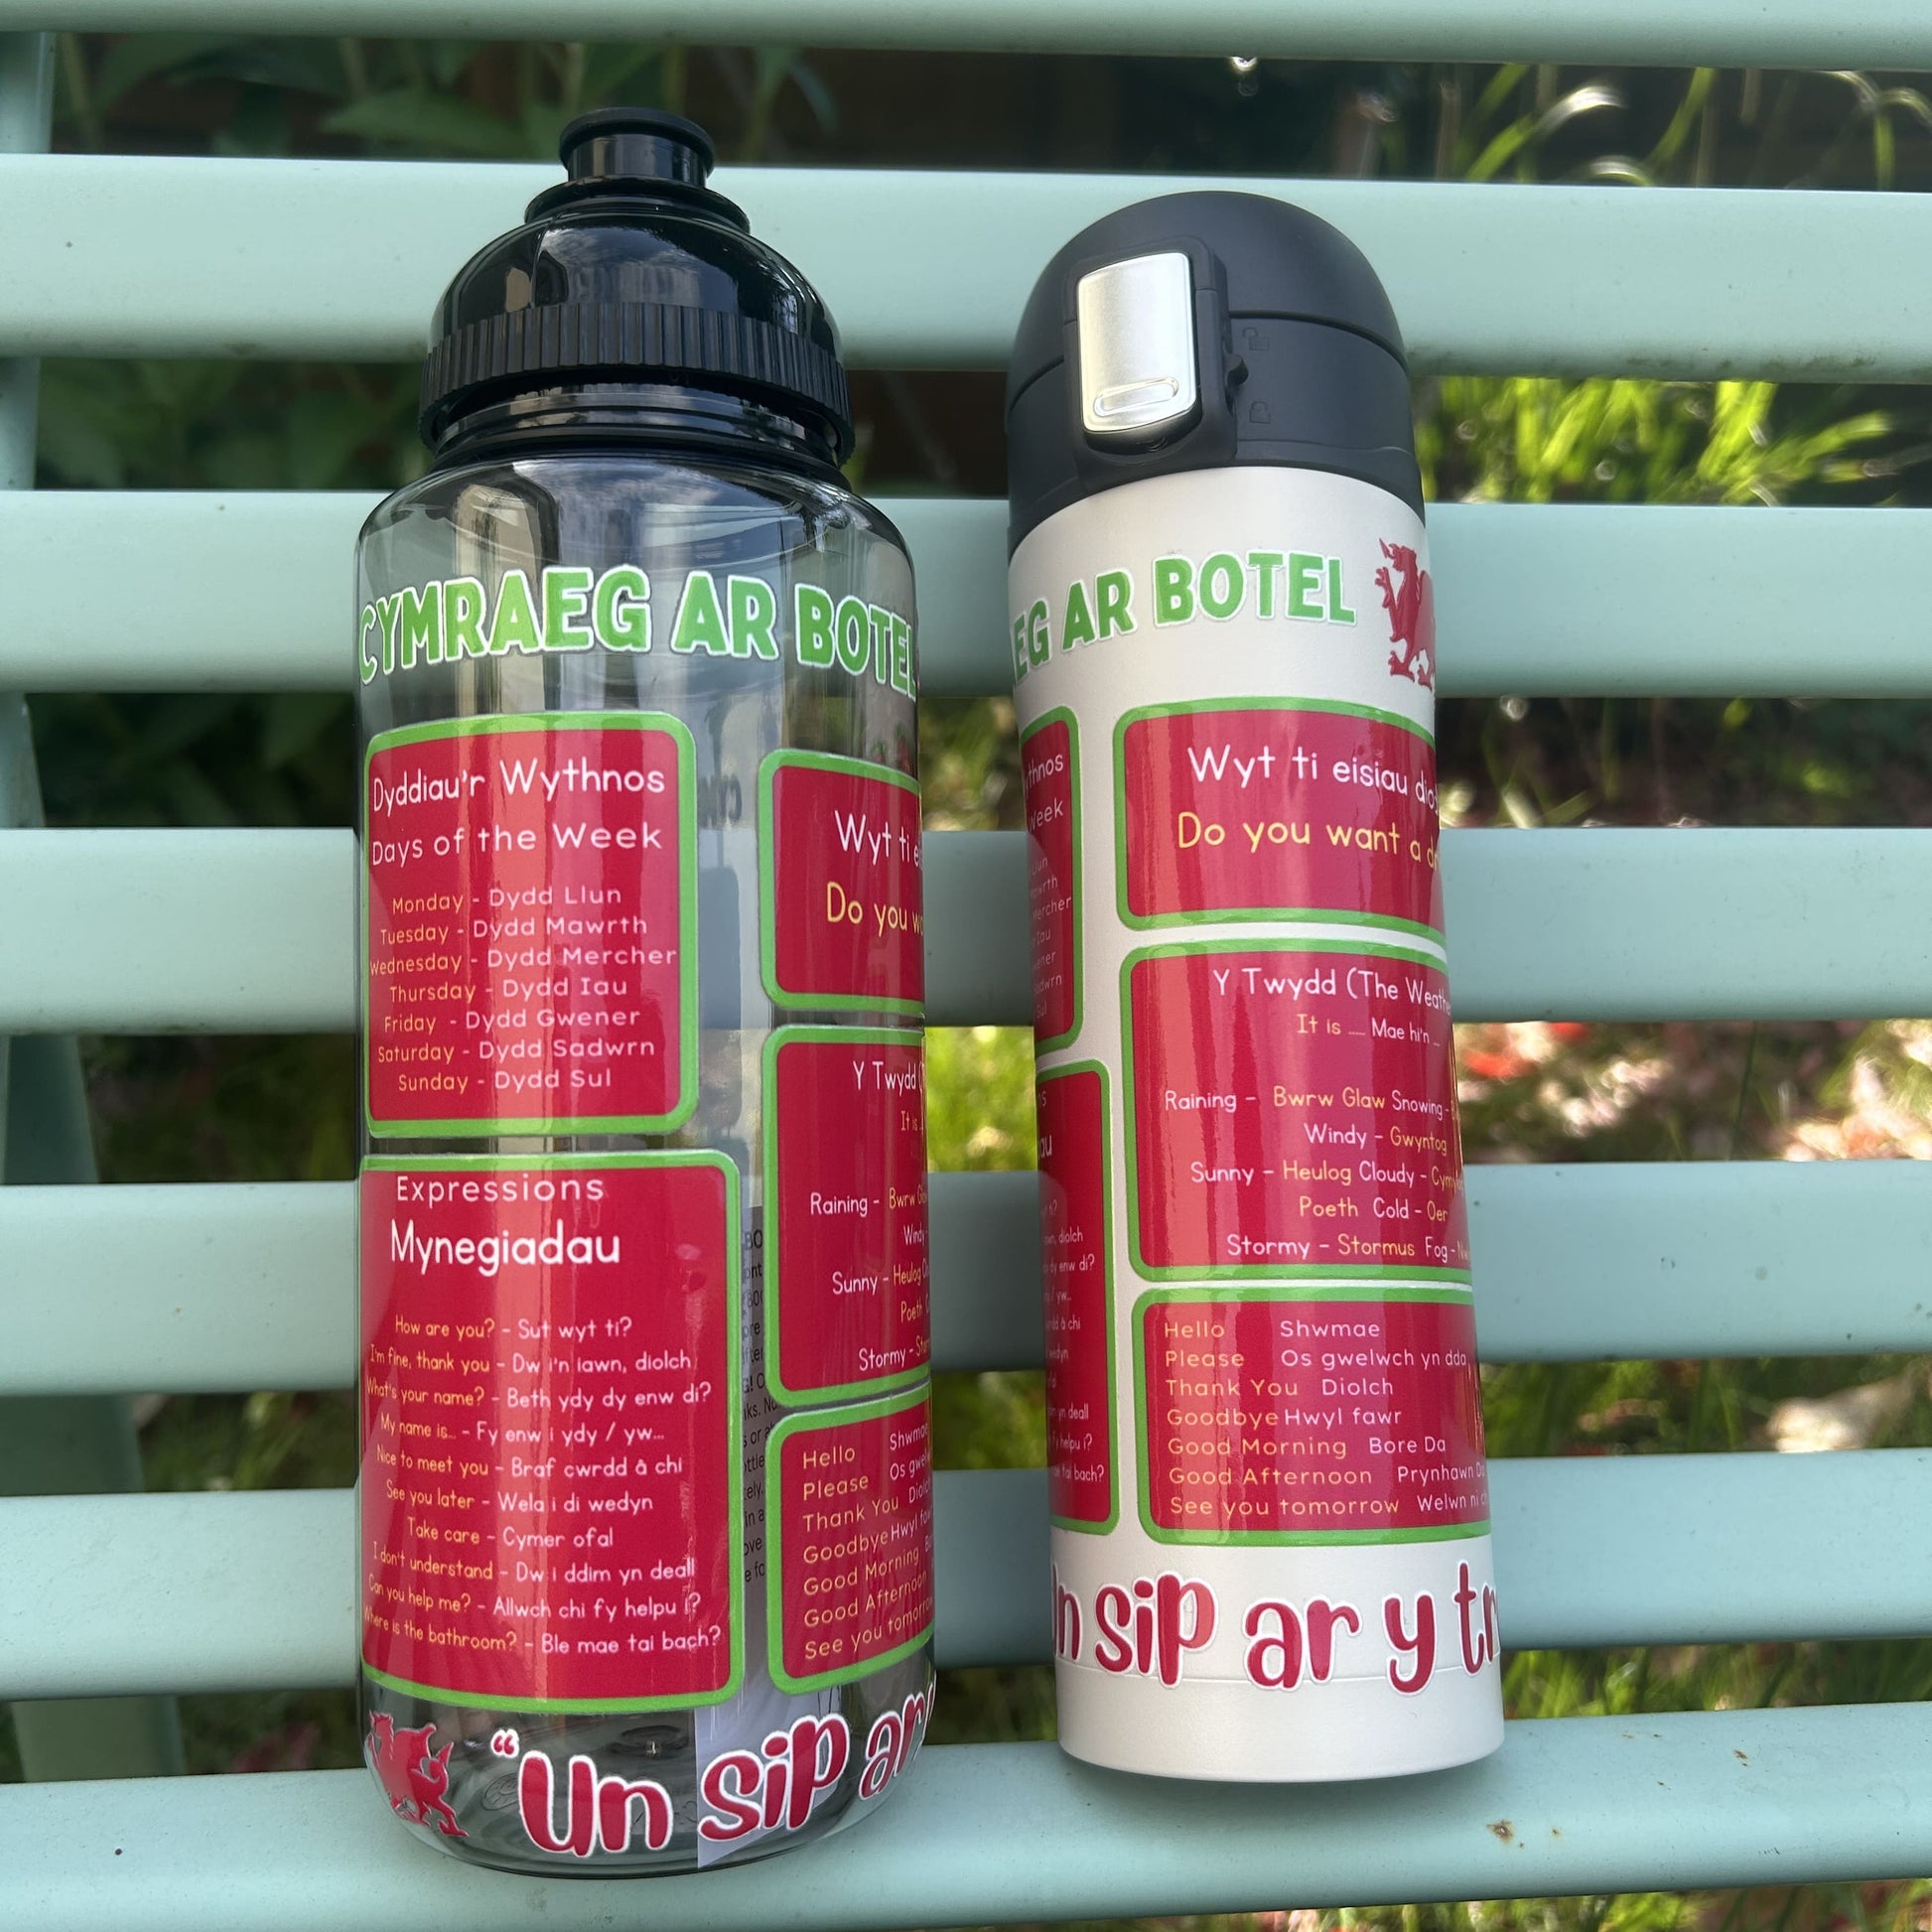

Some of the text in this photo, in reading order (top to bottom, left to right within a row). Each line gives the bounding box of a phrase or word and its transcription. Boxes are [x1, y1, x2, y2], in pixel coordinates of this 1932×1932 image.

[1061, 569, 1138, 653] AR
[1154, 549, 1357, 627] BOTEL
[359, 565, 652, 686] CYMRAEG
[671, 570, 778, 661] AR
[1187, 745, 1408, 796] Wyt ti eisiau
[373, 757, 665, 816] Dyddiau'r Wythnos
[372, 822, 662, 868] Days the Week
[835, 810, 892, 865] Wyt
[1178, 812, 1225, 848] Do
[1243, 822, 1311, 854] you
[1326, 823, 1400, 854] want
[392, 887, 621, 914] Monday Dydd Llun
[827, 882, 863, 924] Do
[874, 903, 907, 937] you
[380, 916, 646, 945] Tuesday Dydd Mawrth
[370, 946, 676, 975] Wednesday Dydd Mercher
[390, 976, 626, 1004] Thursday Dydd Iau
[1242, 967, 1399, 1001] Twydd (The
[385, 1009, 640, 1035] Friday Dydd Gwener
[1372, 1018, 1405, 1039] Mae
[378, 1038, 654, 1064] Saturday Dydd Sadwrn
[398, 1068, 611, 1093] Sunday Dydd Sul
[873, 1061, 915, 1096] Twydd
[1165, 1091, 1236, 1113] Raining
[1274, 1086, 1333, 1108] Bwrw
[1342, 1087, 1385, 1108] Glaw
[1392, 1090, 1443, 1121] Snowing
[1305, 1123, 1447, 1157] Windy Gwyntog
[1191, 1161, 1415, 1187] Sunny Heulog Cloudy
[397, 1173, 604, 1208] Expressions
[811, 1192, 868, 1217] Raining
[1301, 1196, 1408, 1219] Poeth Cold
[391, 1219, 620, 1277] Mynegiadau
[1227, 1233, 1415, 1260] Stormy Stormus
[833, 1272, 878, 1295] Sunny
[395, 1314, 632, 1342] How are you? Sut wyt ti?
[1166, 1320, 1380, 1338] Hello Shwmae
[417, 1349, 691, 1376] thank you Dw diolch
[859, 1347, 905, 1371] Stormy
[1166, 1349, 1414, 1371] Please Os gwelwch
[401, 1382, 711, 1413] your name? Beth ydy dy enw di?
[1167, 1378, 1393, 1396] Thank You Diolch
[1167, 1407, 1402, 1430] Goodbye Hwyl fawr
[400, 1421, 597, 1448] name Fy enw ydy
[1168, 1437, 1446, 1459] Good Morning Bore Da
[418, 1455, 627, 1479] meet you Braf cwrdd
[803, 1446, 855, 1469] Hello
[803, 1475, 869, 1500] Please
[1170, 1467, 1371, 1485] Good Afternoon
[410, 1487, 653, 1516] you later Wela wedyn
[803, 1496, 898, 1532] Thank You
[1171, 1497, 1399, 1519] See you tomorrow
[407, 1517, 614, 1551] Take care Cymer ofal
[803, 1531, 888, 1564] Goodbye
[410, 1555, 695, 1586] understand Dw ddim yn deall
[804, 1547, 918, 1596] Good Morning
[409, 1586, 676, 1623] help me? Allwch chi fy helpu
[804, 1571, 926, 1627] Good Afternoon
[404, 1620, 721, 1653] the bathroom? Ble mae tai bach?
[805, 1625, 882, 1660] See you
[1094, 1571, 1219, 1687] sip
[1244, 1596, 1362, 1691] ar
[1382, 1592, 1436, 1694] y
[699, 1714, 850, 1842] sip
